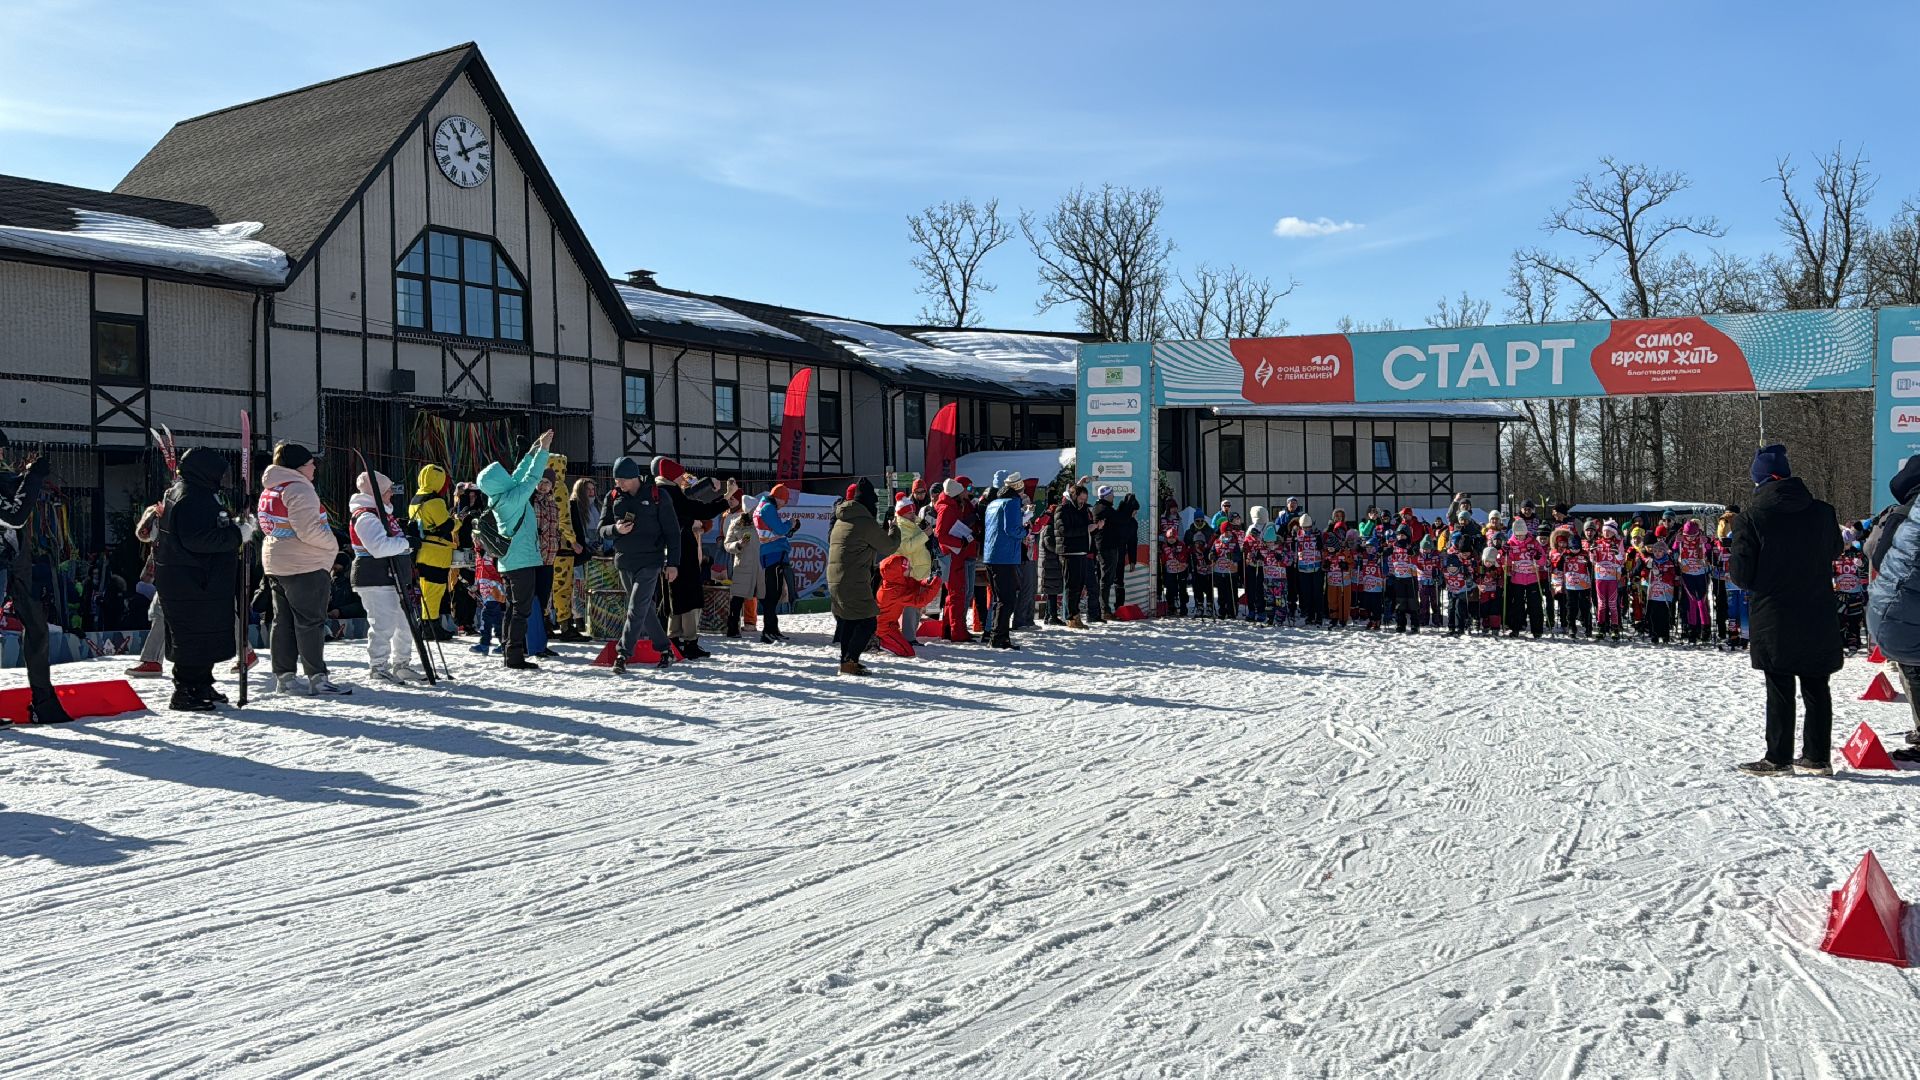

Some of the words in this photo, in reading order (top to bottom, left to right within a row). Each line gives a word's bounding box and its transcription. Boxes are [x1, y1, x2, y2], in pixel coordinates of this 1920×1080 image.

[1301, 364, 1333, 373] БОРЬБЫ
[1382, 338, 1576, 391] СТАРТ
[1277, 373, 1283, 381] С
[1284, 371, 1333, 381] ЛЕЙКЕМИЕЙ
[1091, 427, 1116, 436] Альфа
[1116, 426, 1136, 435] Банк
[1365, 566, 1377, 575] 59
[1567, 563, 1580, 572] 93
